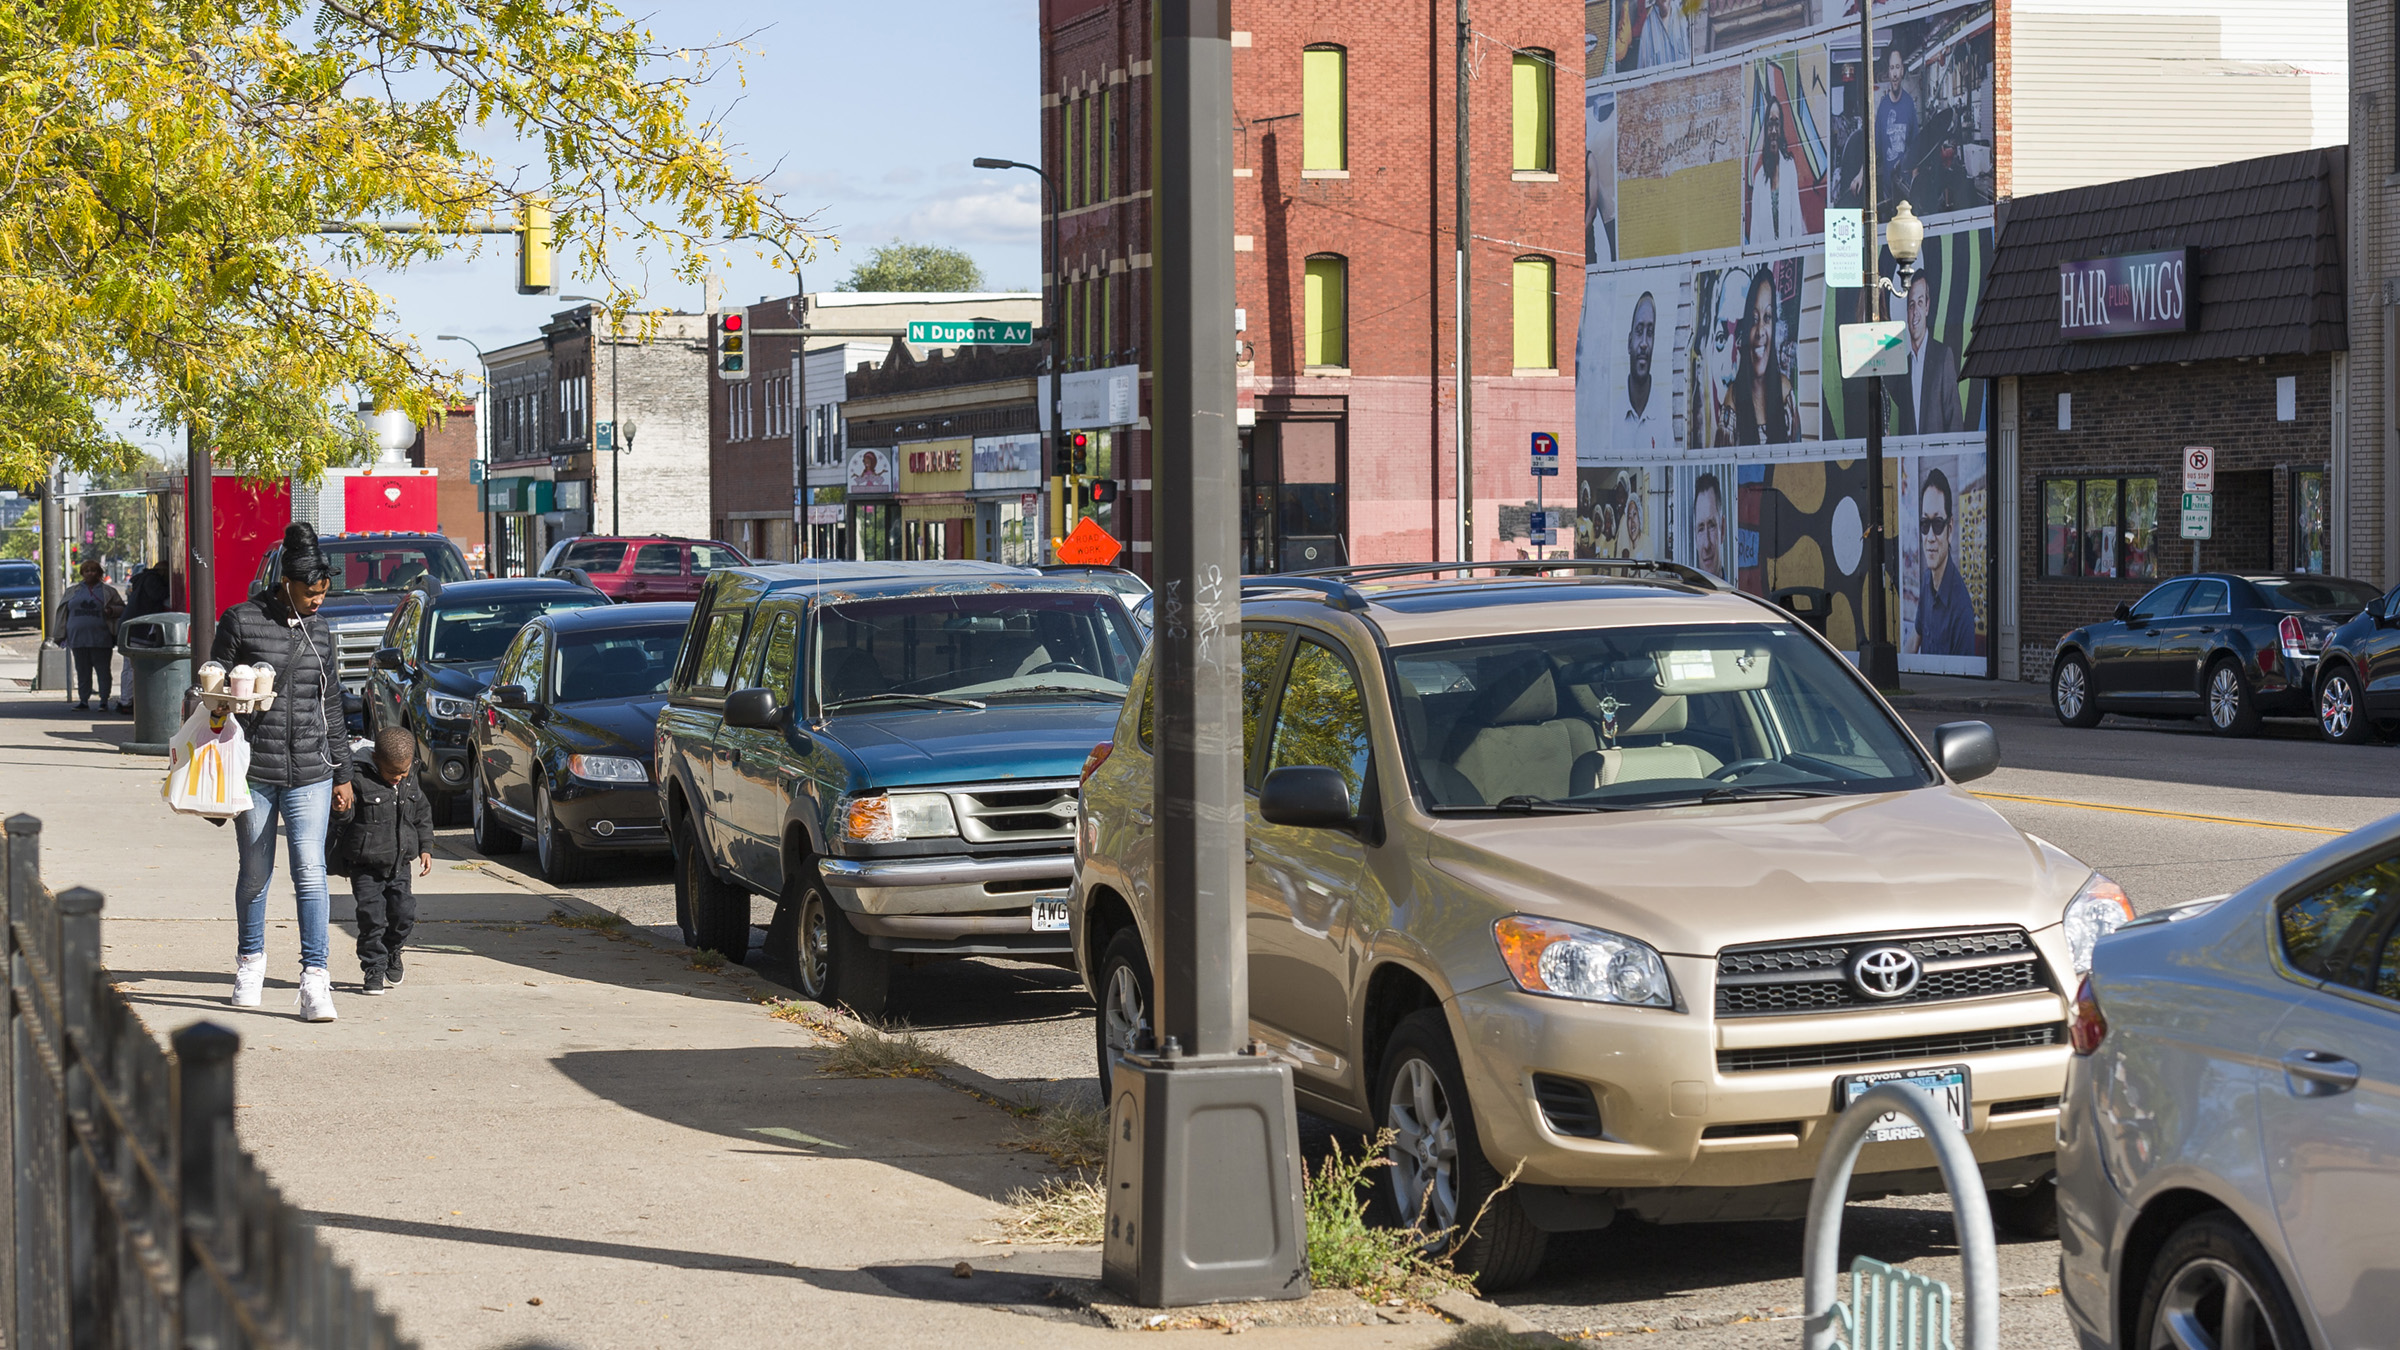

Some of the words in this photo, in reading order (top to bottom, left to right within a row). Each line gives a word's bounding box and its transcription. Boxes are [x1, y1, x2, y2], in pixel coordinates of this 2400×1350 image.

[2060, 269, 2110, 328] HAIR
[2109, 283, 2129, 307] PLUS
[2129, 259, 2183, 323] WIGS
[912, 325, 924, 339] N
[931, 325, 995, 342] Dupont
[1003, 326, 1026, 339] Av
[1076, 533, 1100, 544] ROAD
[1077, 545, 1101, 555] WORK
[1864, 1072, 1902, 1082] TOYOTA
